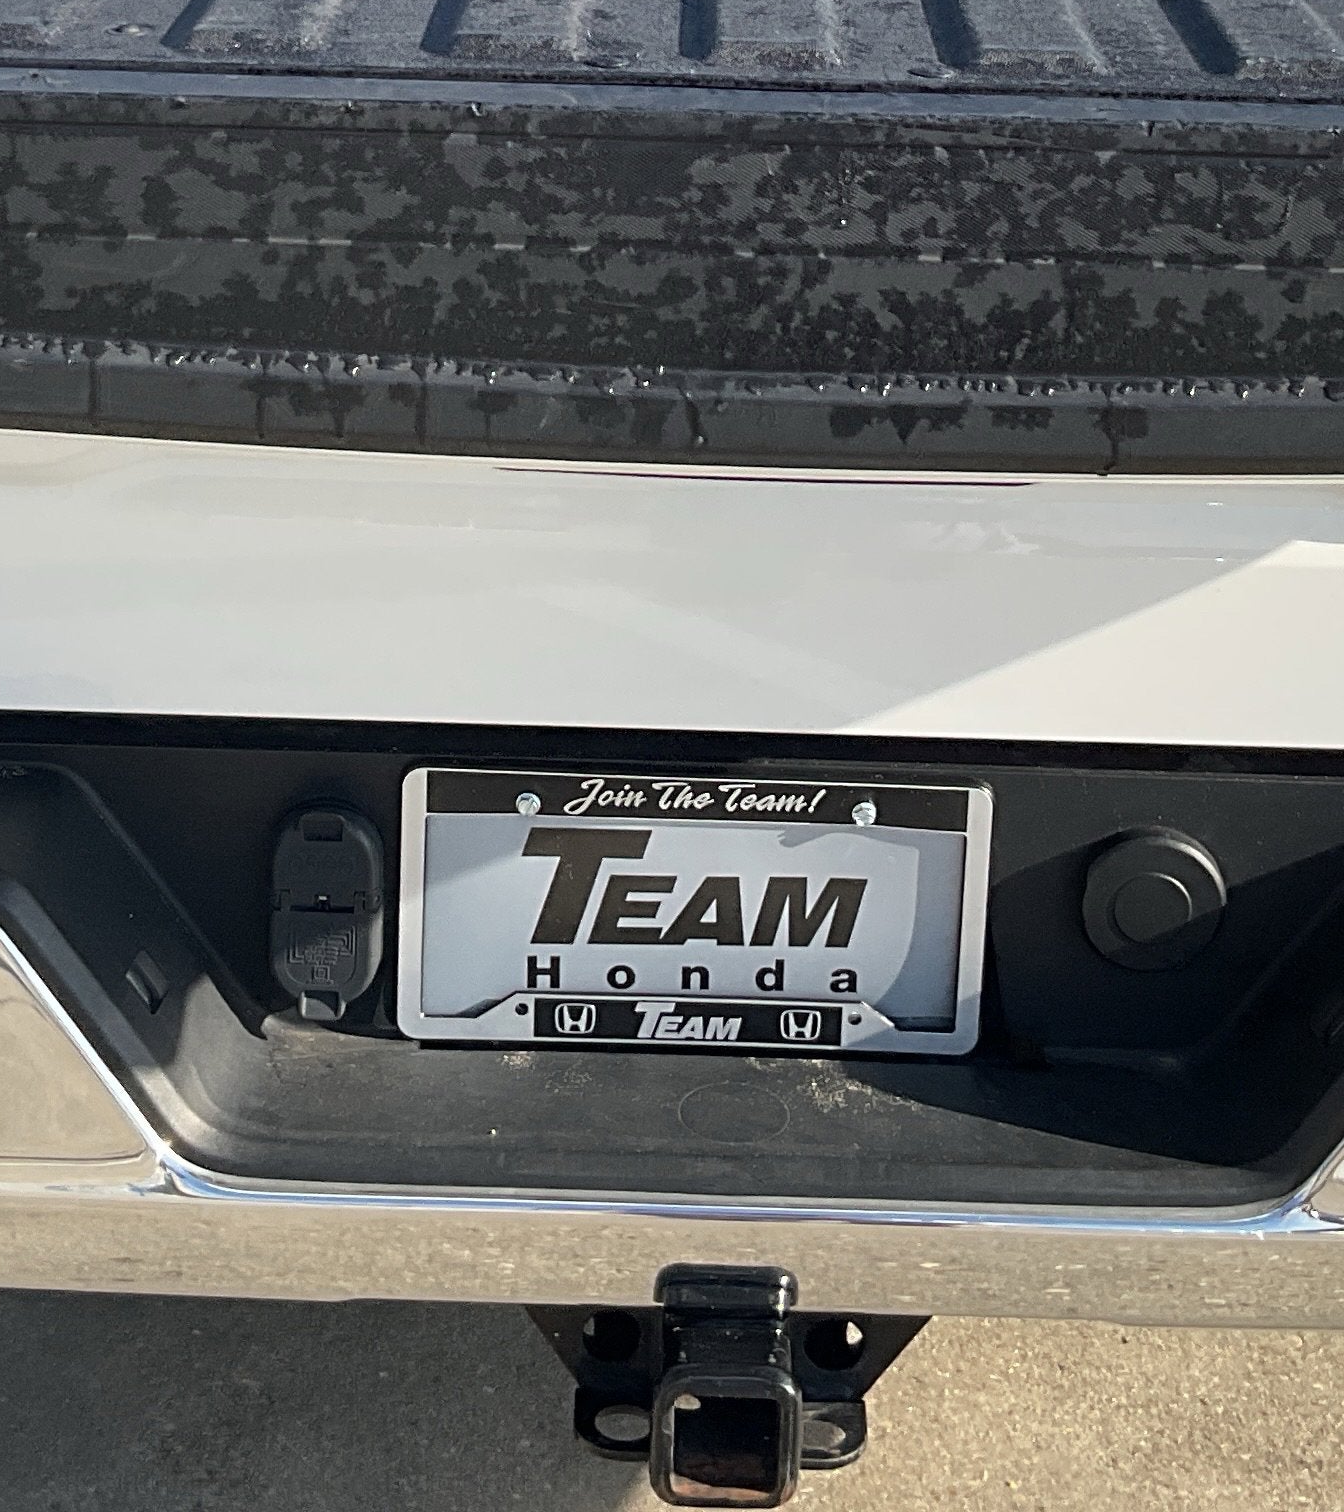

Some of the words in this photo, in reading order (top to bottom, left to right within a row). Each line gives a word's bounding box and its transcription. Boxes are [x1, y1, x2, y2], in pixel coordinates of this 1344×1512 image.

[563, 778, 647, 815] Join
[651, 781, 715, 810] The
[718, 783, 827, 814] Team!
[522, 826, 868, 948] TEAM
[526, 954, 859, 994] Honda
[633, 1001, 743, 1042] TEAM
